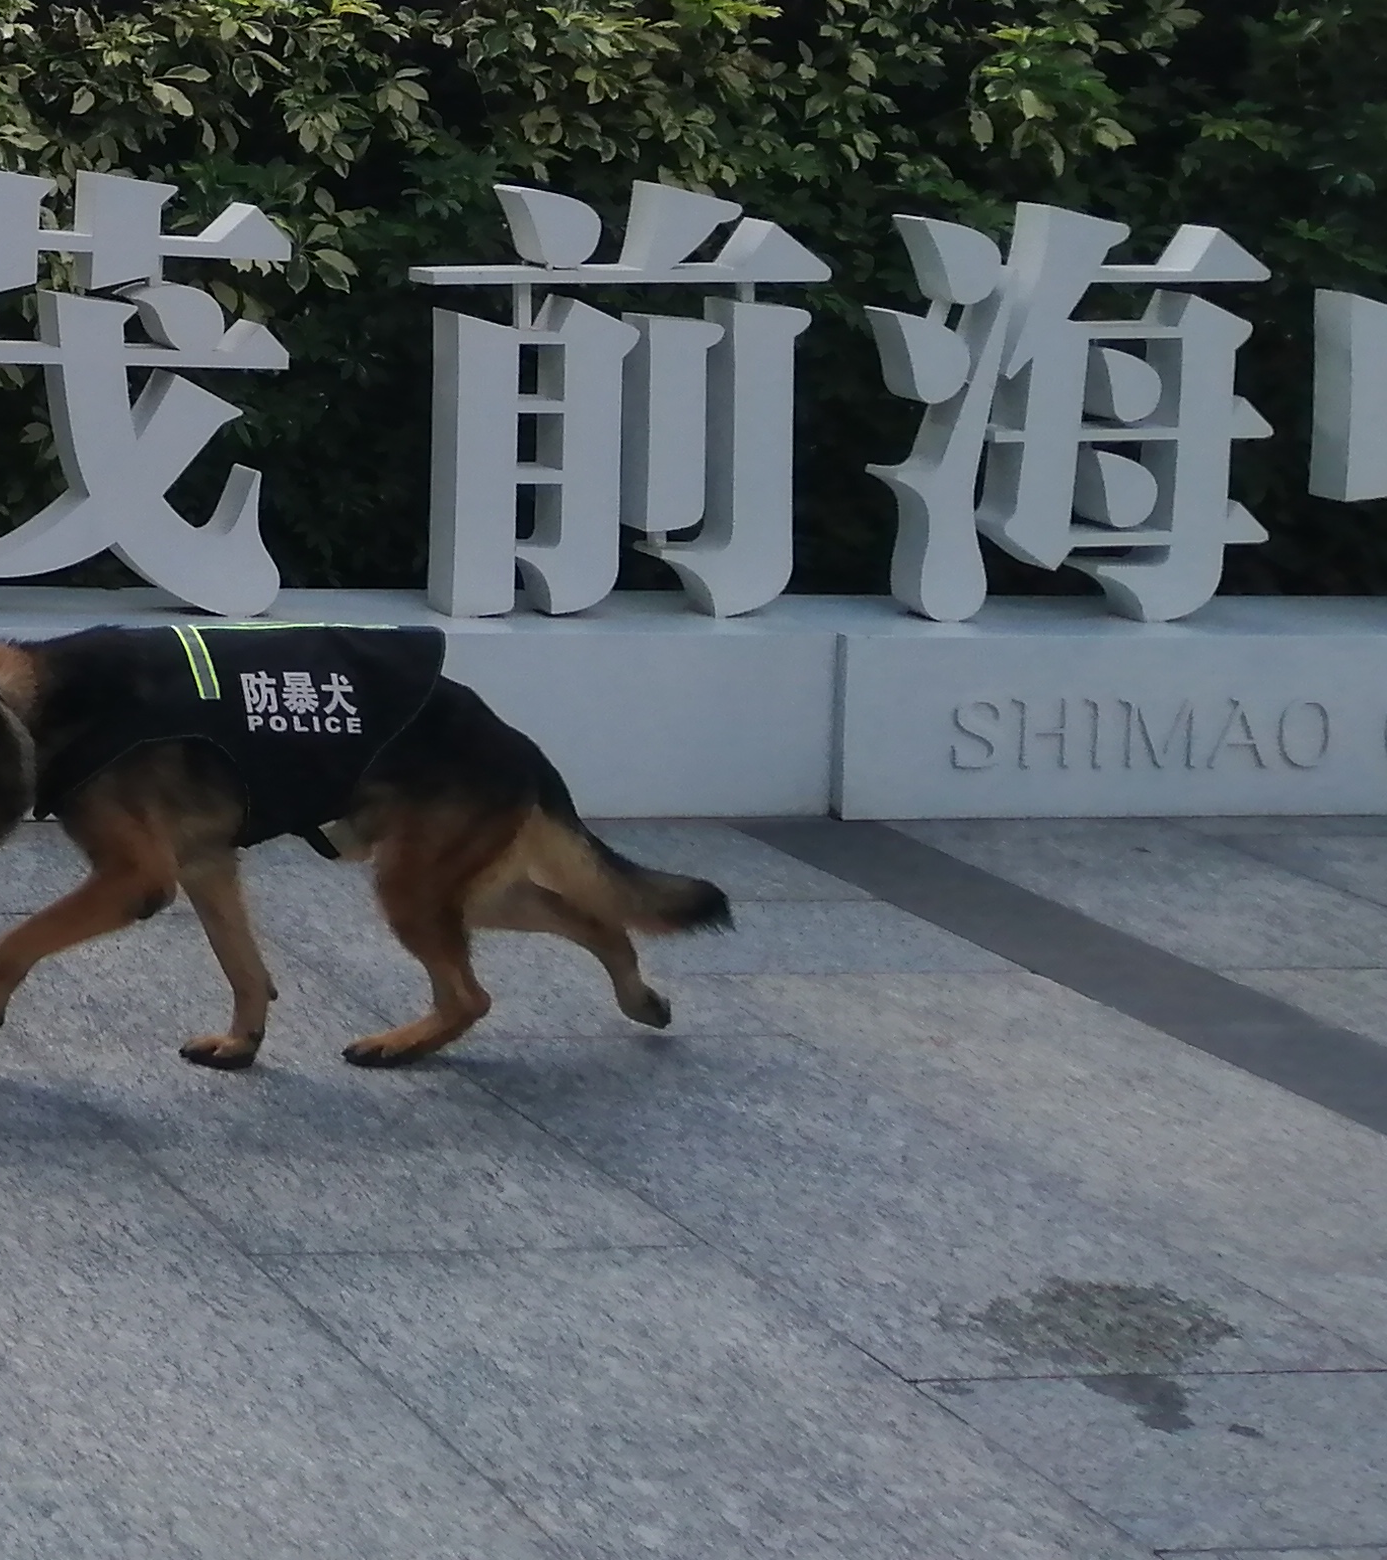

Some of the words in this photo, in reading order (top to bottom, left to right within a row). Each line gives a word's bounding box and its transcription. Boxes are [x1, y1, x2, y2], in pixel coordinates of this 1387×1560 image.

[239, 671, 358, 715] 防暴犬
[247, 715, 363, 735] POLICE
[949, 697, 1329, 771] SHIMAO
